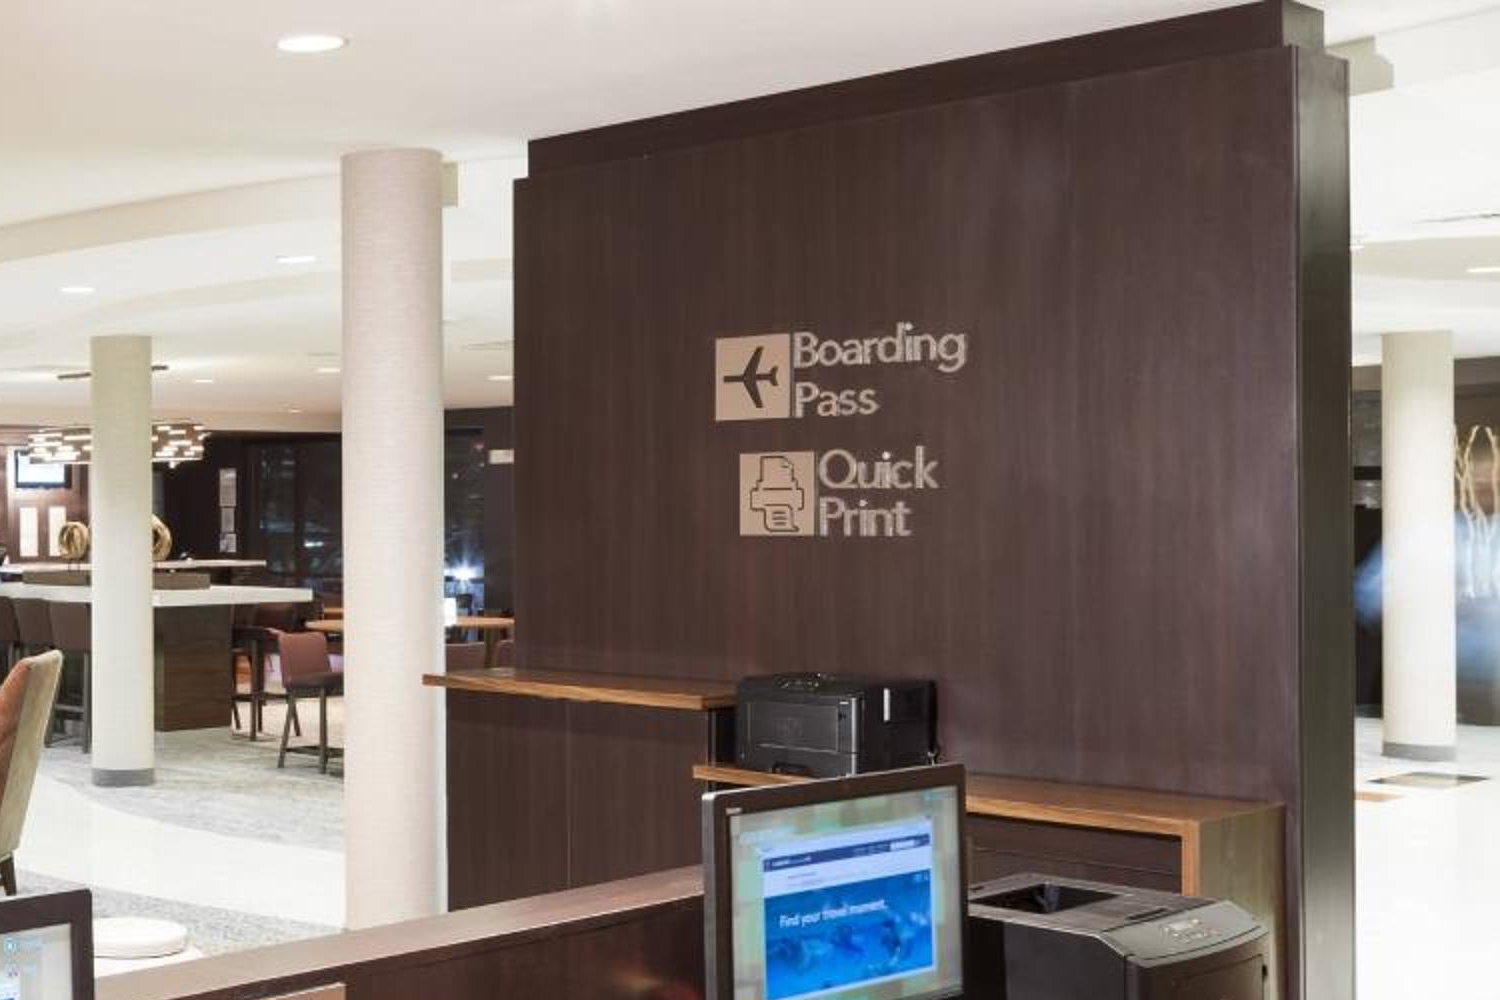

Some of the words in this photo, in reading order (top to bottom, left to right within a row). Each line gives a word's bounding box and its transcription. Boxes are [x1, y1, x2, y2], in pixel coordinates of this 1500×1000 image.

[793, 321, 967, 373] Boarding
[795, 381, 879, 418] Pass
[818, 445, 939, 489] Quick
[818, 496, 912, 537] Print
